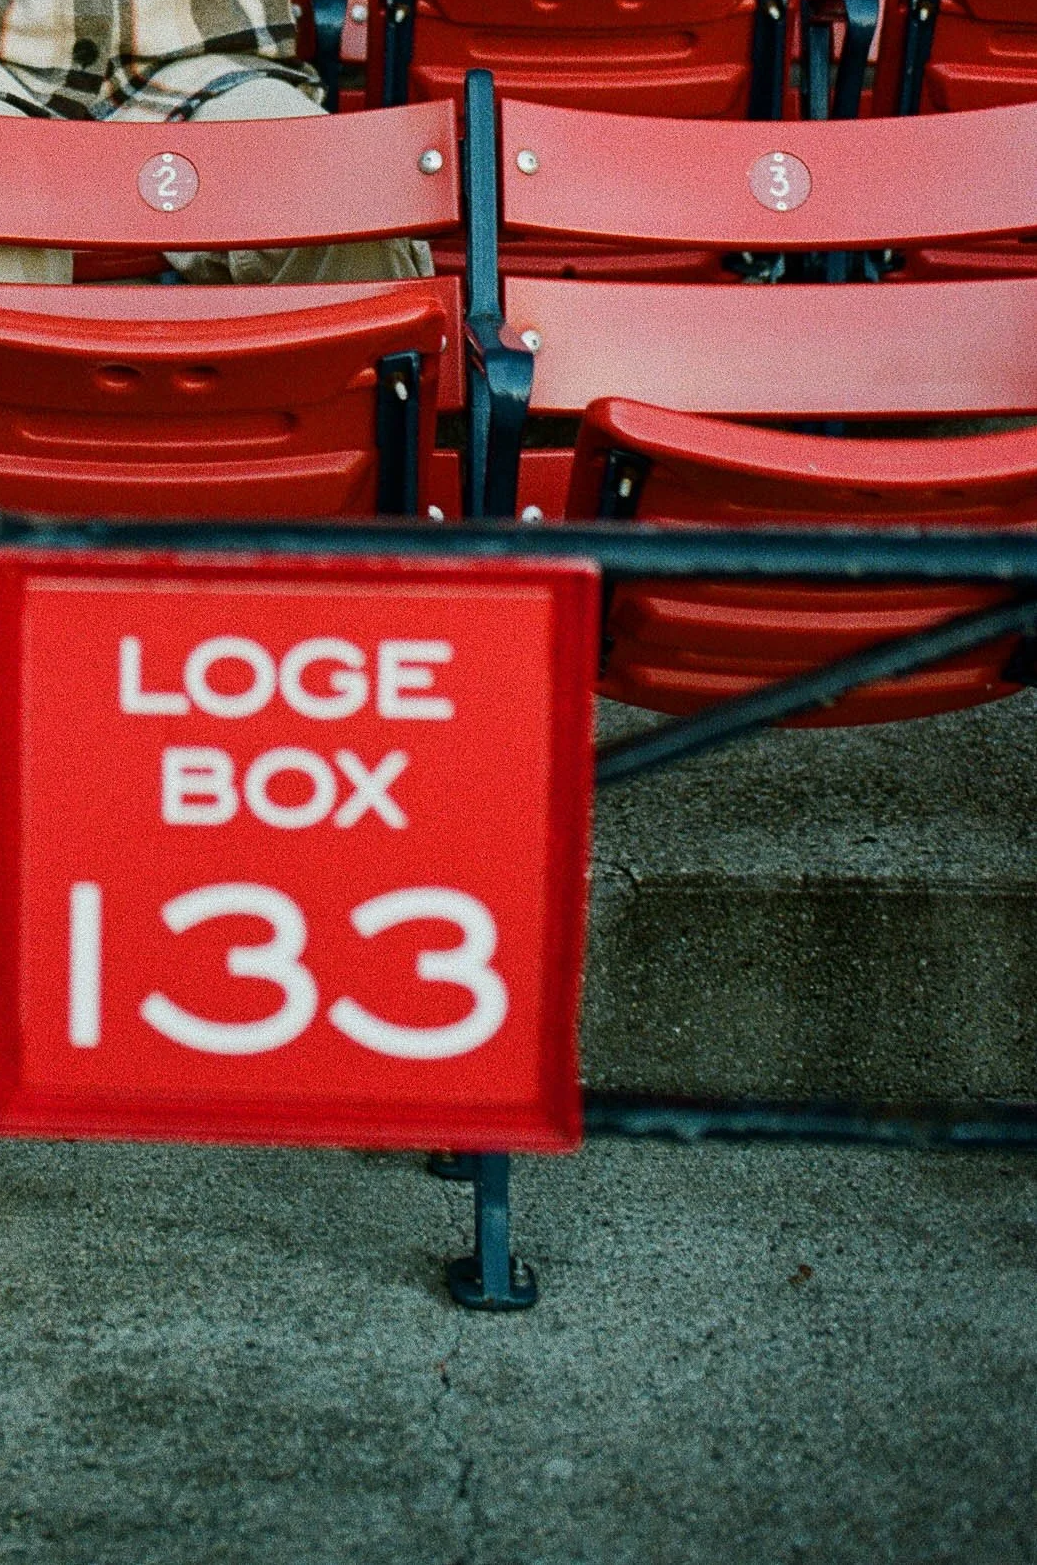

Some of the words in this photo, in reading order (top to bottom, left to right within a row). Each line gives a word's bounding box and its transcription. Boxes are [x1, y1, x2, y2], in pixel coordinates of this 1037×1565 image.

[152, 166, 178, 196] 2
[769, 166, 790, 197] 3
[118, 634, 456, 721] LOGE
[161, 744, 410, 831] BOX
[67, 880, 510, 1062] 133
